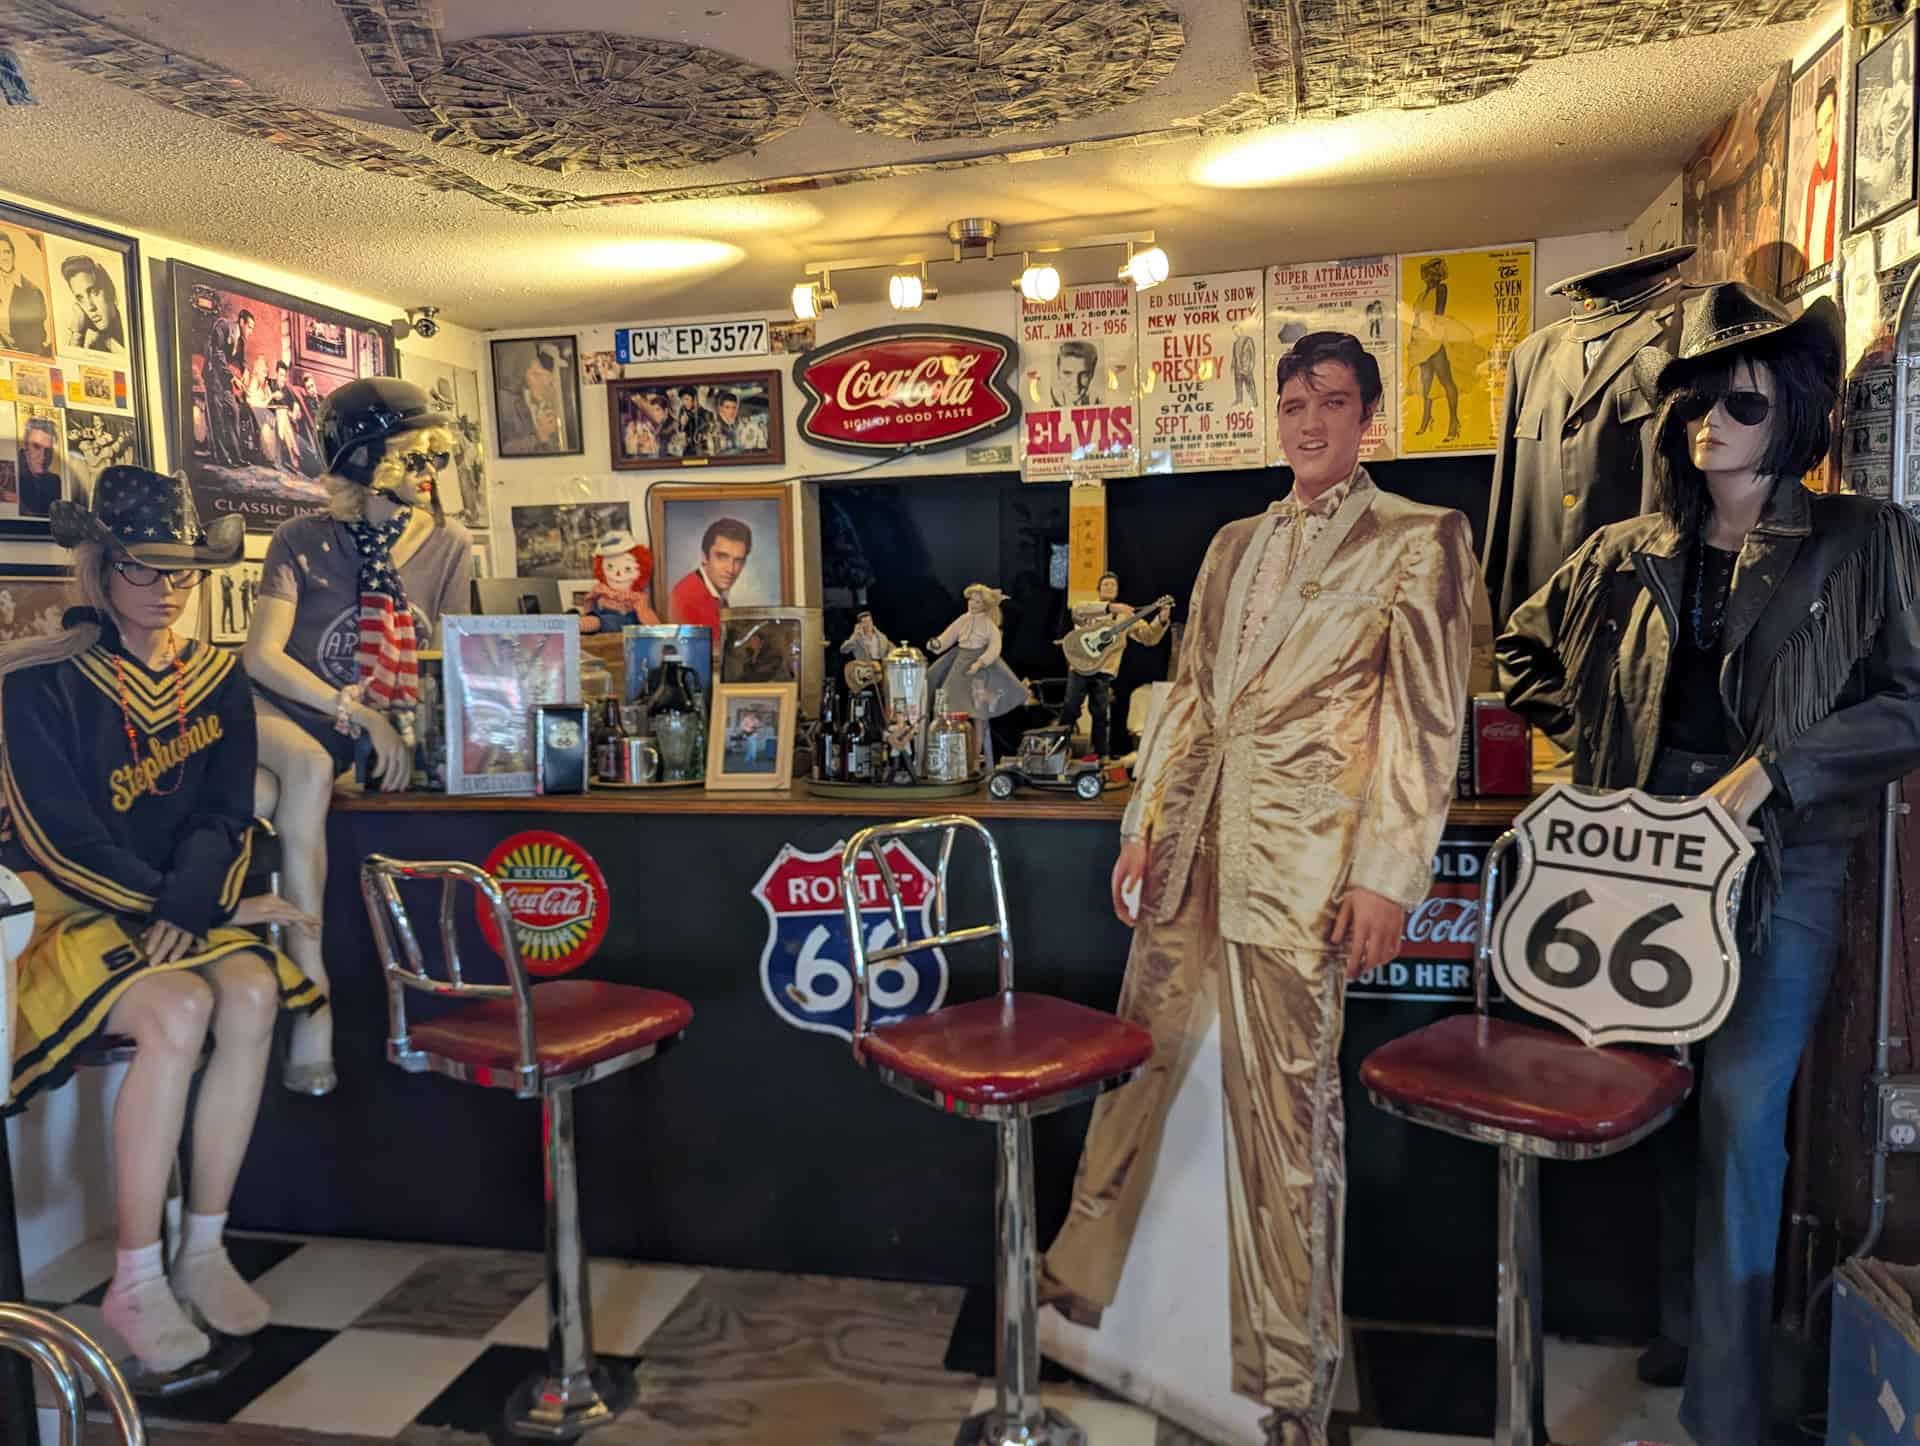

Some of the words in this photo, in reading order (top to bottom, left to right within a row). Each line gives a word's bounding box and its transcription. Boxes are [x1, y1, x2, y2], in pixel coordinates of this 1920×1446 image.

[1273, 270, 1308, 286] SUPER
[1314, 264, 1389, 282] ATTRACTIONS
[1075, 288, 1129, 311] AUDITORIUM
[1149, 295, 1163, 309] ED
[1168, 289, 1219, 307] SULLIVAN
[1224, 287, 1256, 303] SHOW
[1494, 280, 1522, 297] SEVEN
[1496, 297, 1520, 314] YEAR
[1055, 322, 1077, 338] JAN.
[1081, 321, 1093, 337] 21
[1103, 318, 1128, 335] 1956
[1148, 313, 1176, 328] NEW
[1184, 310, 1220, 325] YORK
[1226, 306, 1257, 322] CITY
[676, 328, 704, 355] EP
[709, 324, 764, 353] 3577
[1163, 333, 1212, 360] ELVIS
[837, 351, 982, 411] Coca-Cola
[1169, 382, 1205, 394] LIVE
[1160, 402, 1214, 415] STAGE
[1177, 393, 1198, 403] ON
[842, 418, 873, 430] SIGN
[877, 416, 892, 427] OF
[895, 412, 933, 425] GOOD
[937, 406, 974, 419] TASTE
[1155, 416, 1193, 436] SEPT.
[1200, 414, 1211, 433] 10
[1225, 411, 1254, 432] 1956
[1025, 405, 1133, 456] ELVIS
[214, 497, 289, 516] CLASSIC
[109, 714, 224, 813] Stephanie
[1545, 818, 1706, 873] ROUTE
[535, 868, 568, 879] COLD
[1525, 888, 1693, 1009] 66
[795, 919, 920, 1013] 66
